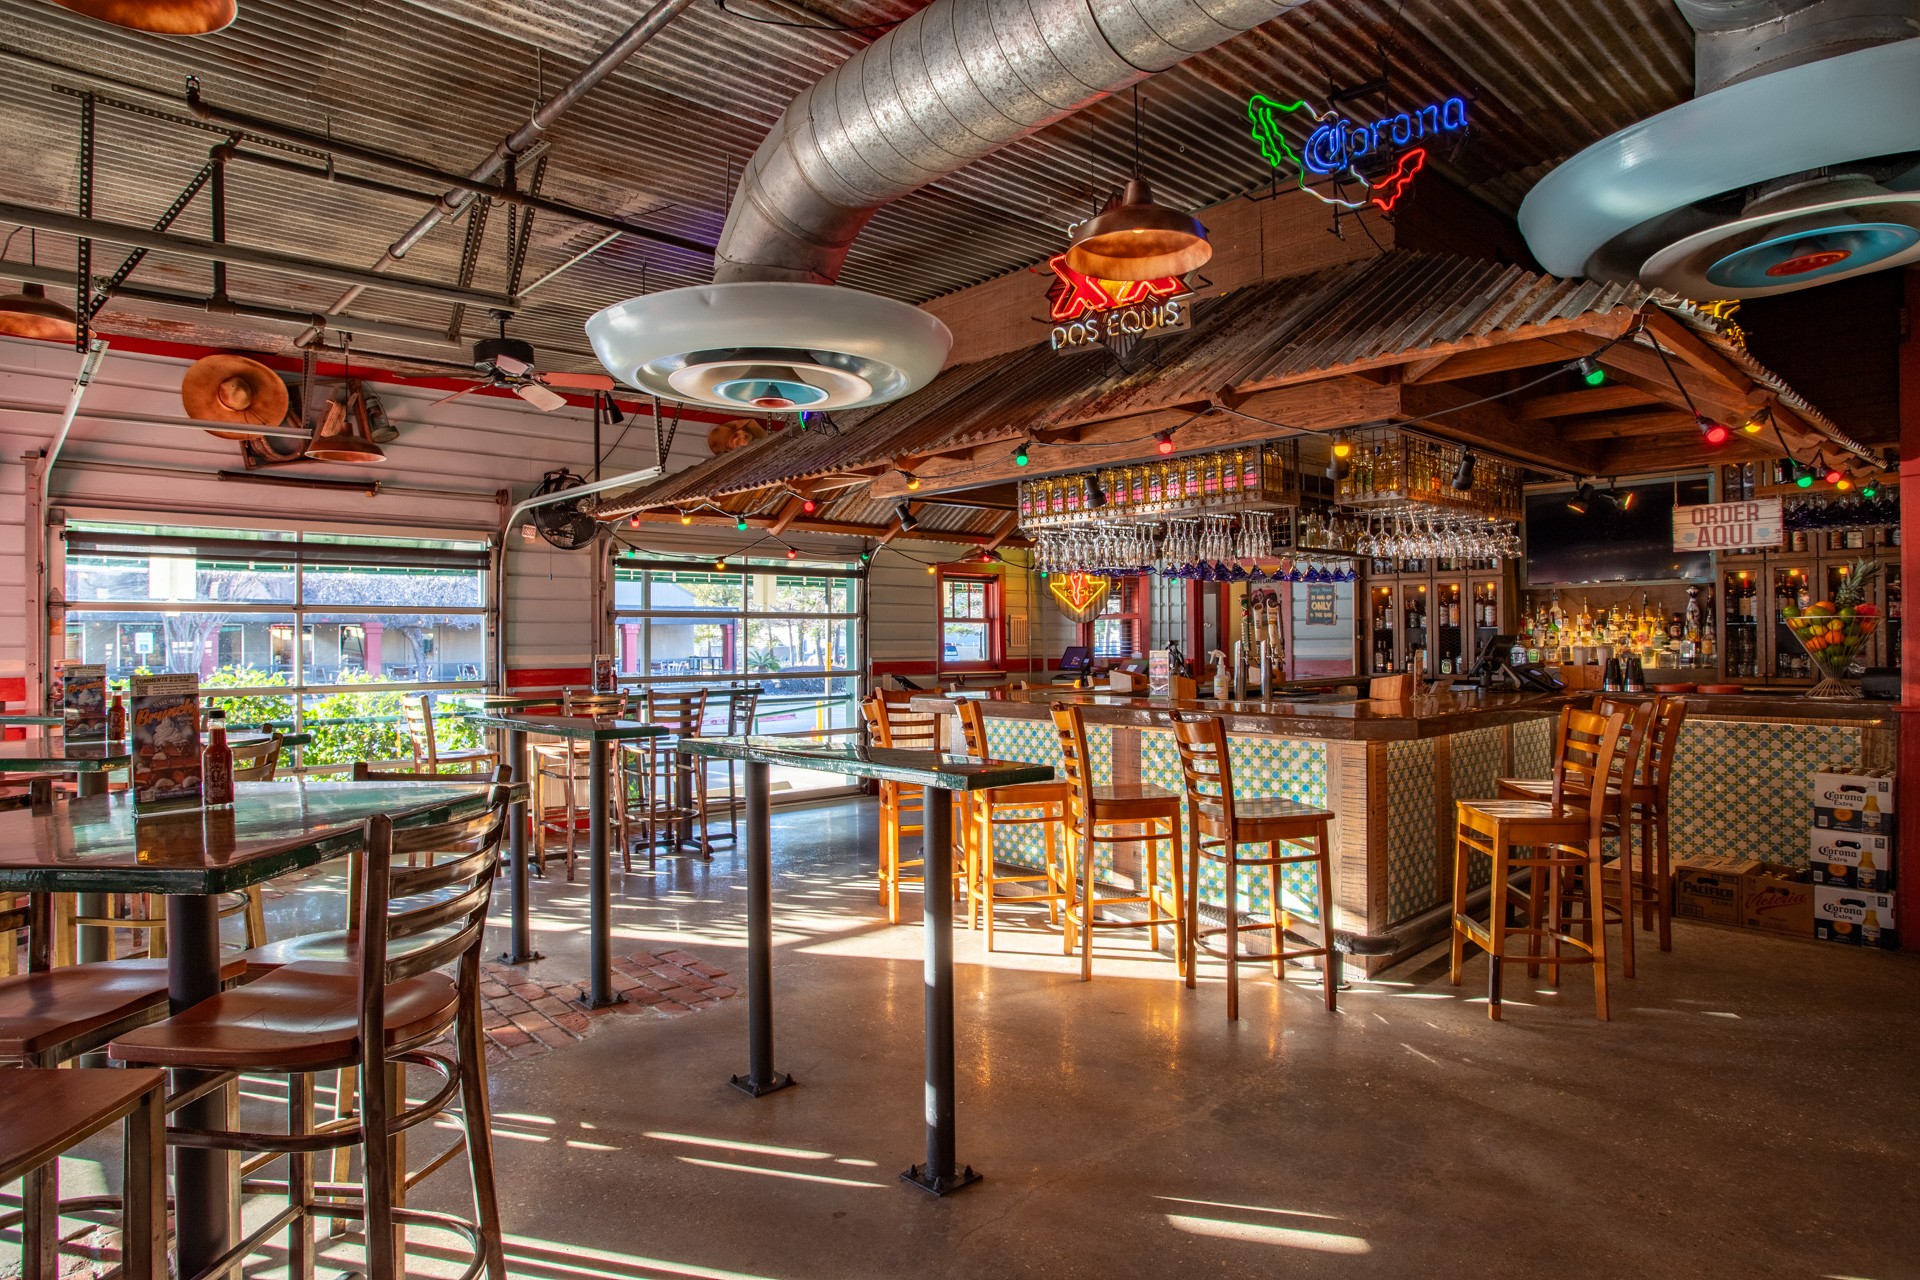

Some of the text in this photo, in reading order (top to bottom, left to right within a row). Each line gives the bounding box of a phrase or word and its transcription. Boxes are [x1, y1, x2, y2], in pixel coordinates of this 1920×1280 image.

[1303, 96, 1469, 175] Corona
[1051, 300, 1181, 351] DOS EQUIS
[1691, 503, 1760, 526] ORDER
[1696, 523, 1754, 548] AQUI
[1311, 601, 1332, 611] ONLY
[135, 676, 169, 685] COMMENTS
[135, 698, 196, 728] Brunch
[1824, 791, 1863, 802] Corona
[1833, 800, 1854, 808] Extra
[1818, 845, 1858, 858] Corona
[1828, 855, 1848, 863] Extra
[1744, 889, 1808, 914] Victoria
[1823, 902, 1863, 916] Corona
[1833, 912, 1854, 921] Extra
